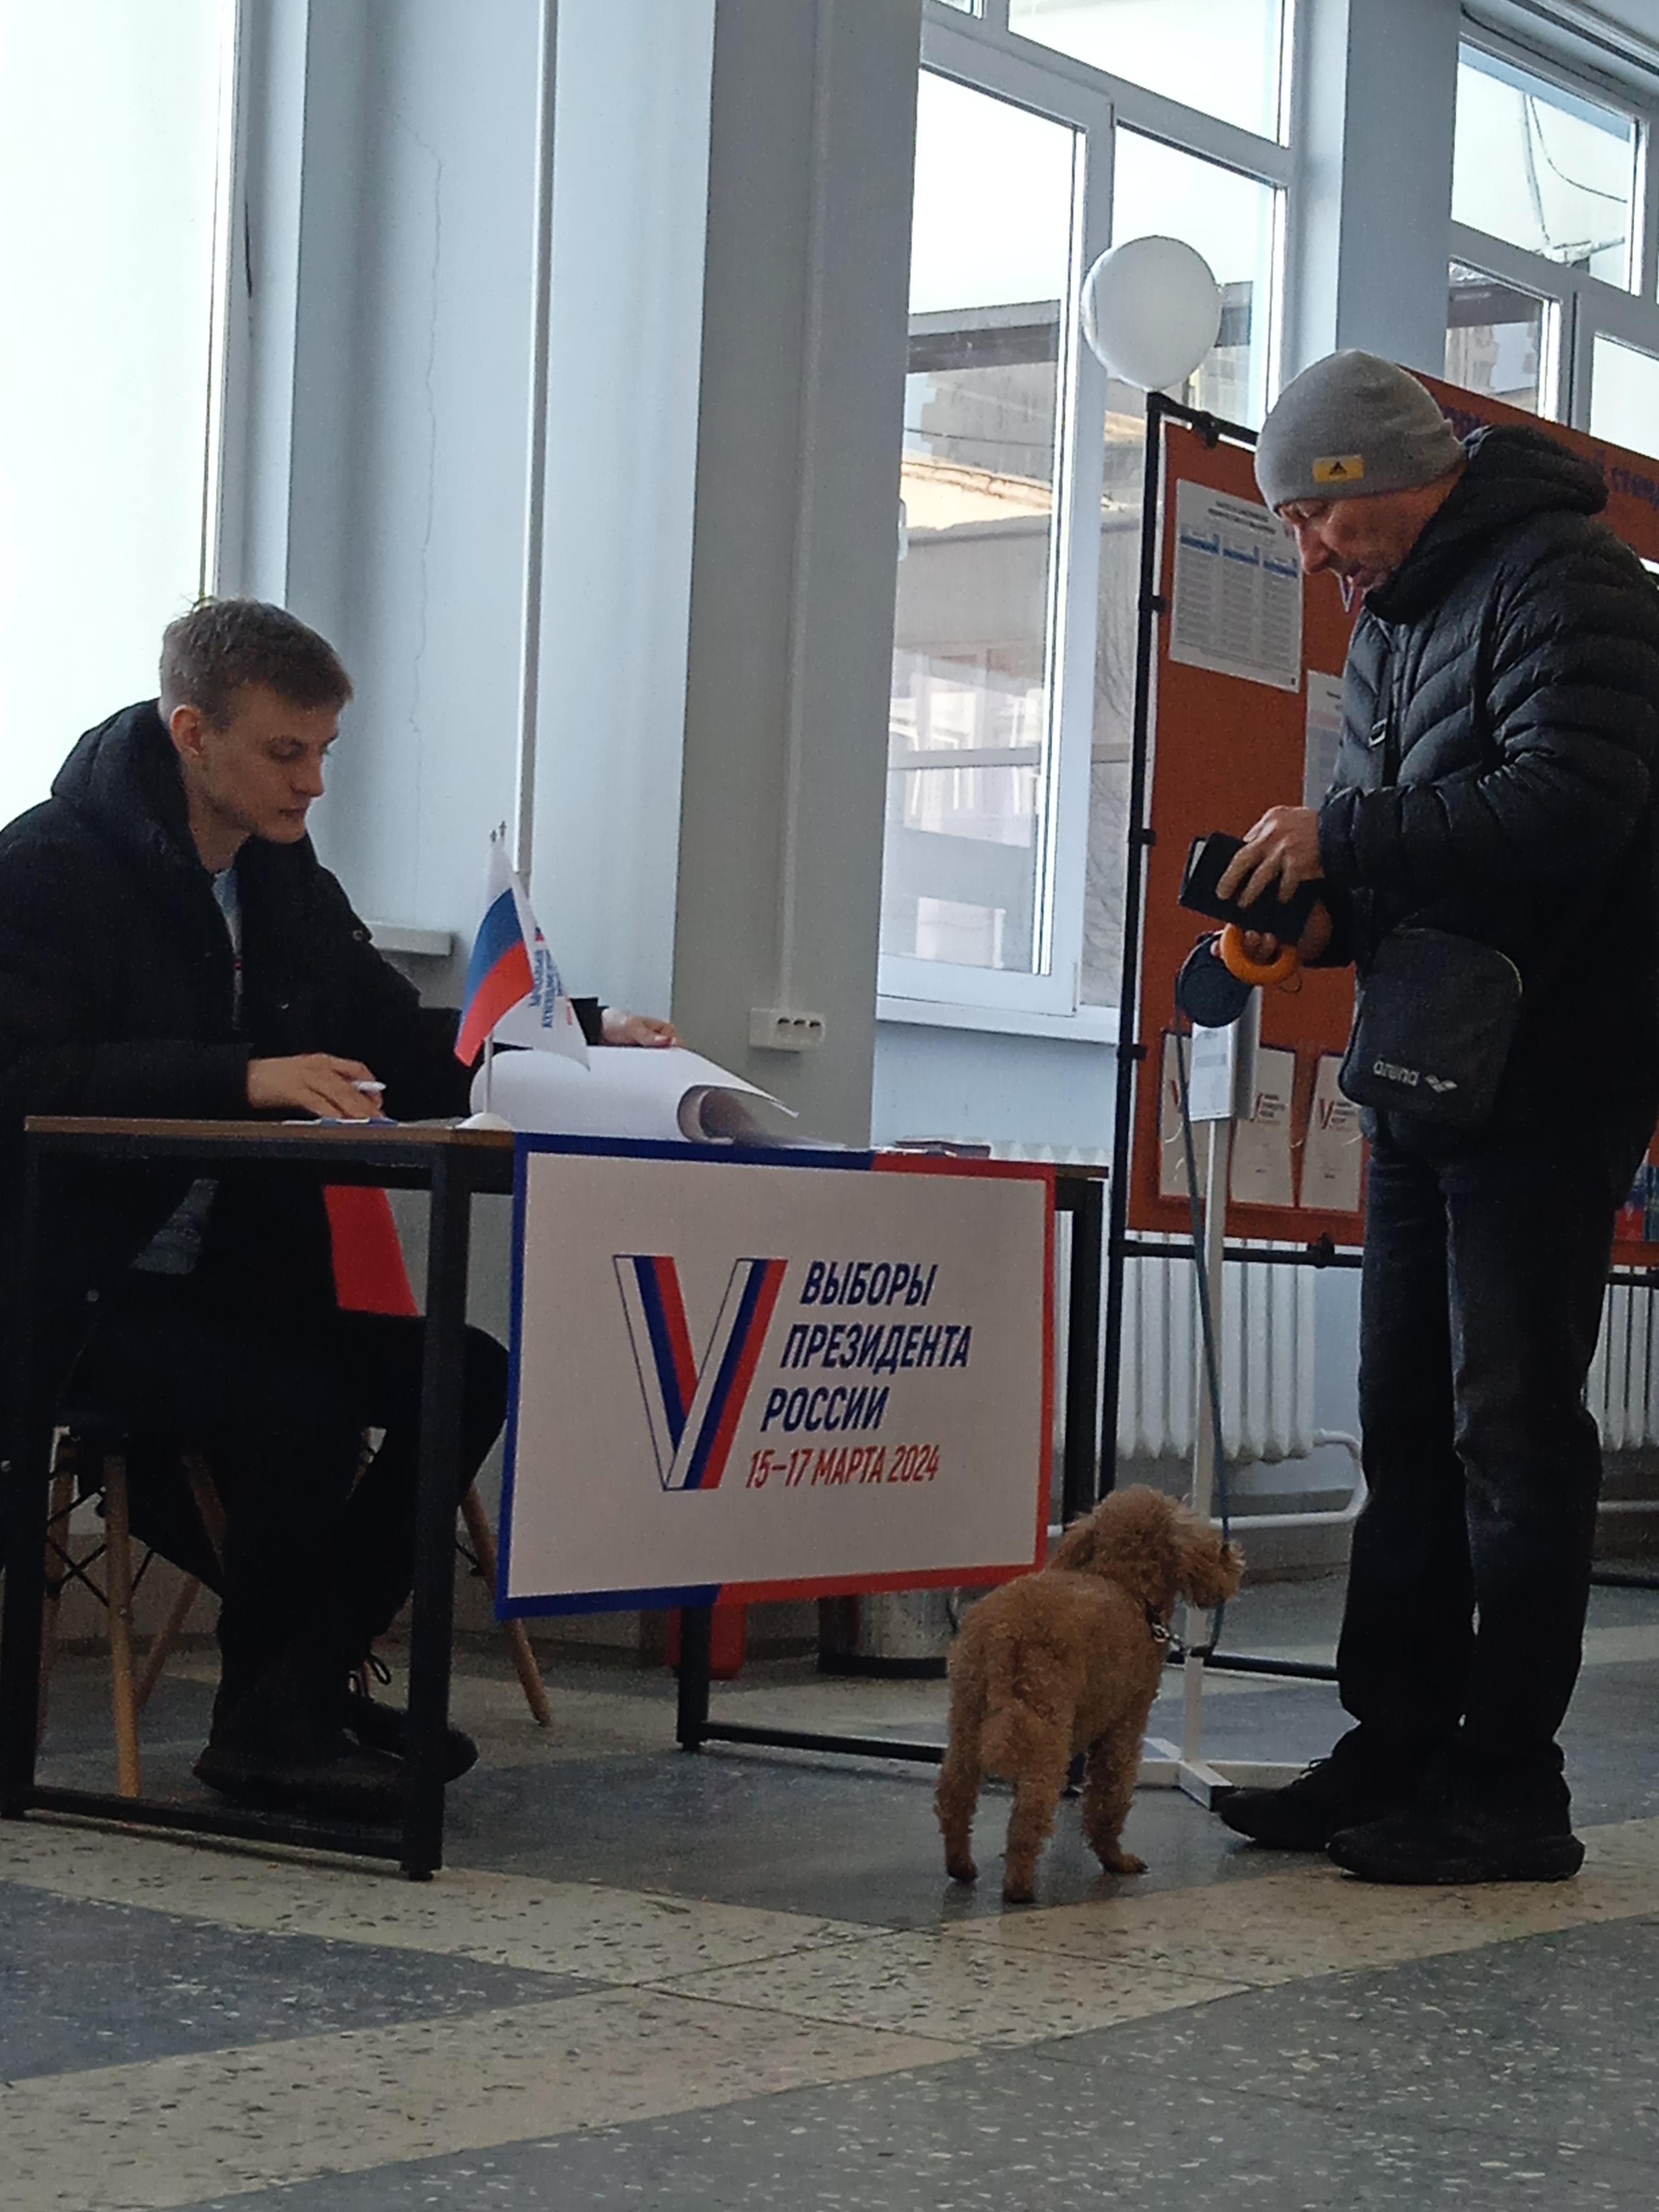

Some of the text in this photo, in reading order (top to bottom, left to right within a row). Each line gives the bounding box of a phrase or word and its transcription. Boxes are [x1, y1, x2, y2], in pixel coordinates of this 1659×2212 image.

[799, 1261, 939, 1306] ВЫБОРЫ
[780, 1323, 973, 1376] ПРЕЗИДЕНТА
[760, 1386, 890, 1432] РОССИИ
[811, 1446, 886, 1485] МАРТА
[886, 1444, 940, 1482] 2024
